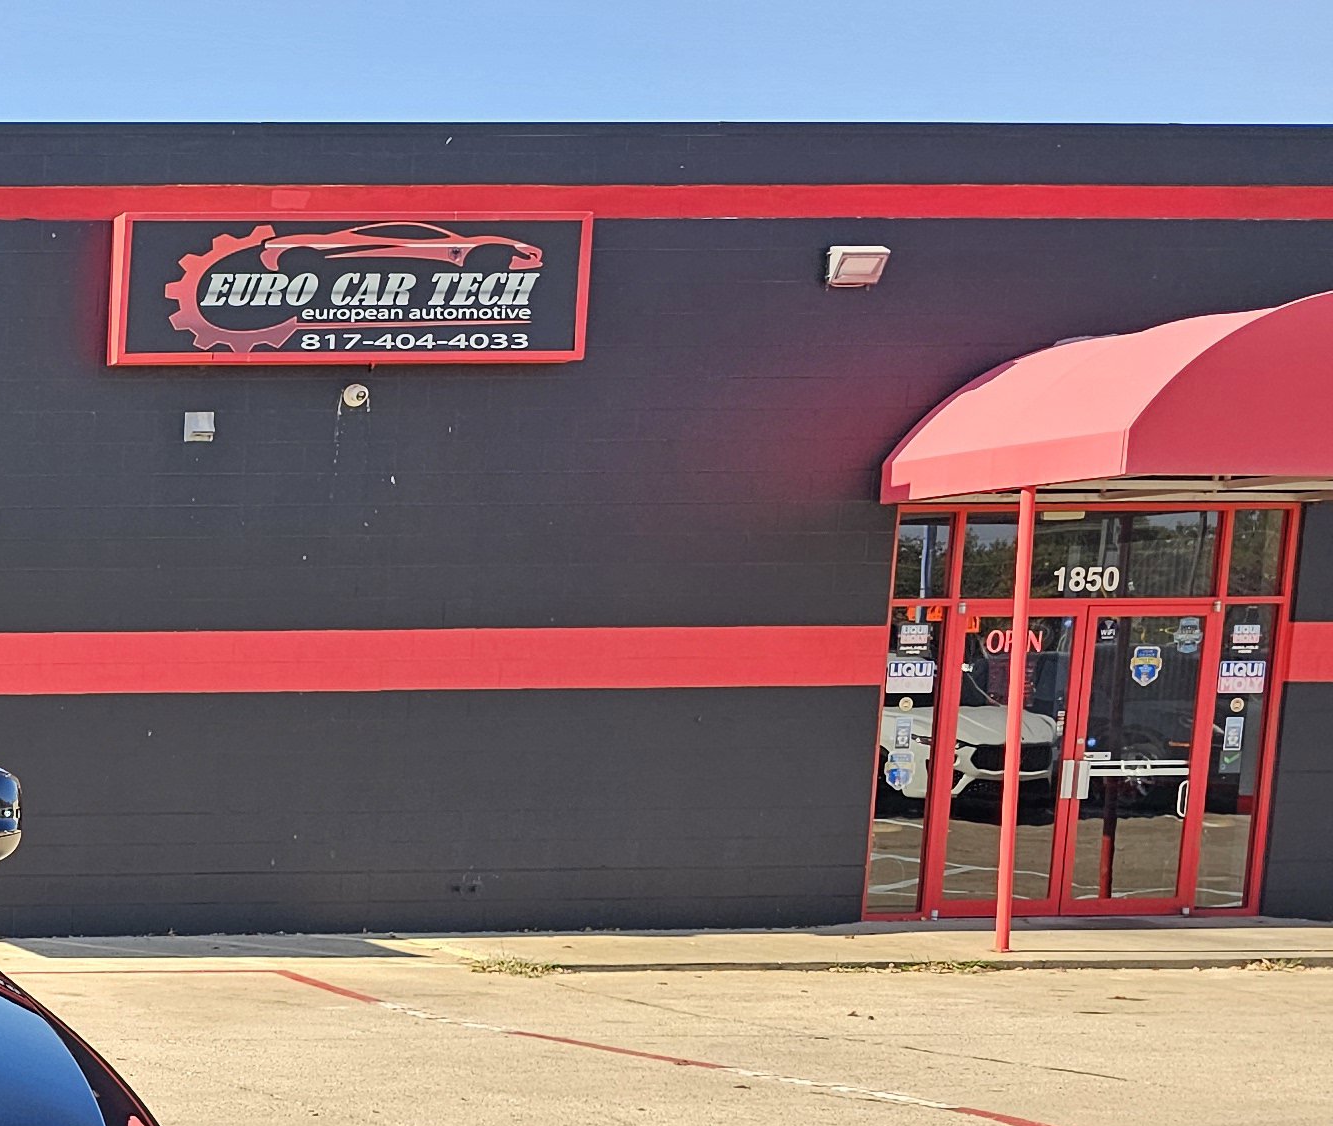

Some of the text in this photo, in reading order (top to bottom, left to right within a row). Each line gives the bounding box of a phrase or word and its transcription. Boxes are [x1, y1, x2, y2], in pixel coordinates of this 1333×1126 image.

[200, 272, 540, 306] EURO CAR TECH
[301, 304, 532, 323] european automotive
[300, 333, 529, 350] 817-404-4033
[1053, 566, 1120, 592] 1850
[986, 629, 1043, 654] OPN
[890, 663, 933, 677] LIQUI
[1221, 663, 1264, 677] LIQUI
[1220, 677, 1263, 691] MOLY
